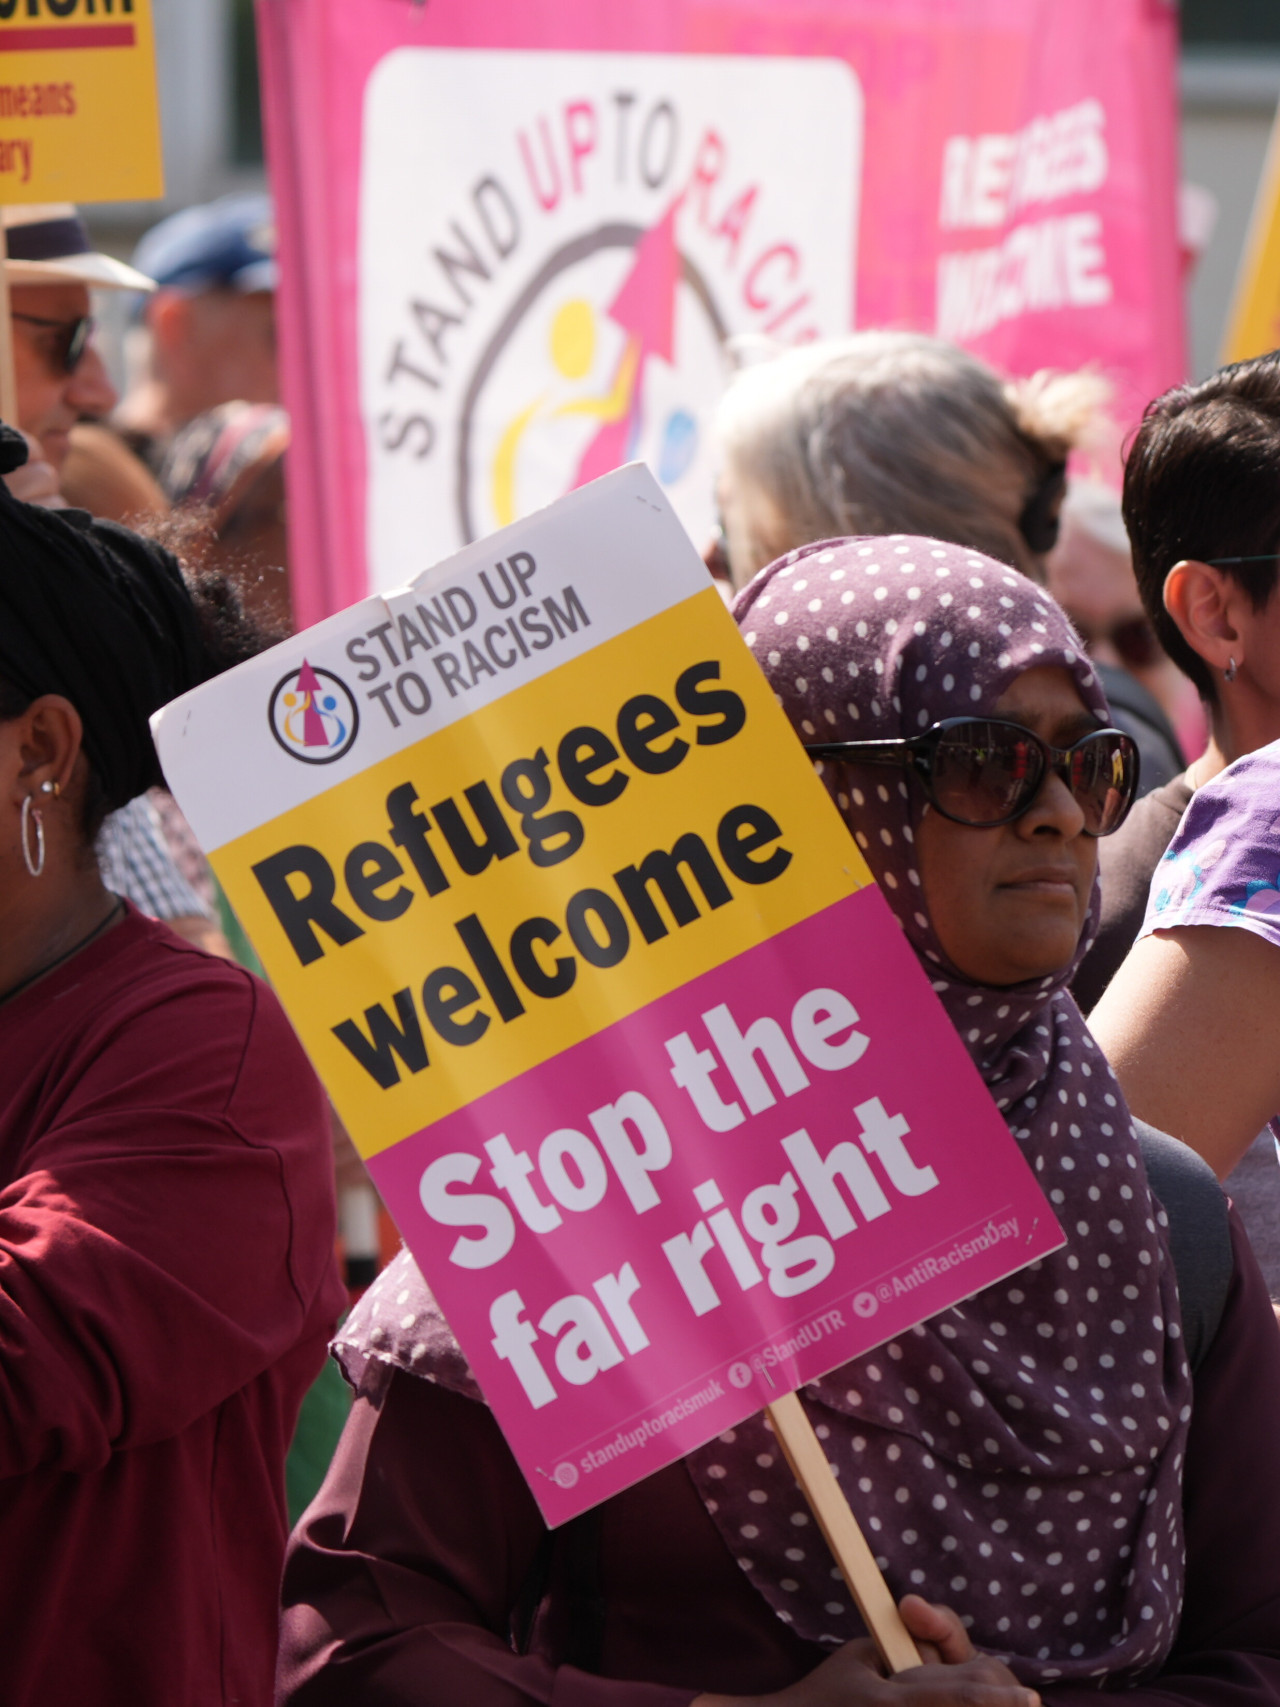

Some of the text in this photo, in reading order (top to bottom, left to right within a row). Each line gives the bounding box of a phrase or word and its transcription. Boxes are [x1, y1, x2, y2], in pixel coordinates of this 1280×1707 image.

[380, 91, 826, 462] STAND UP TO RACI
[346, 551, 537, 682] STAND UP
[366, 585, 592, 729] TO RACISM
[252, 660, 747, 967] Refugees
[331, 803, 793, 1090] welcome
[419, 988, 870, 1270] Stop the
[489, 1096, 939, 1410] far right
[580, 1379, 725, 1474] standuptoracismuk
[750, 1309, 846, 1374] @StandUTR
[876, 1217, 1020, 1303] @AntiRacismDay
